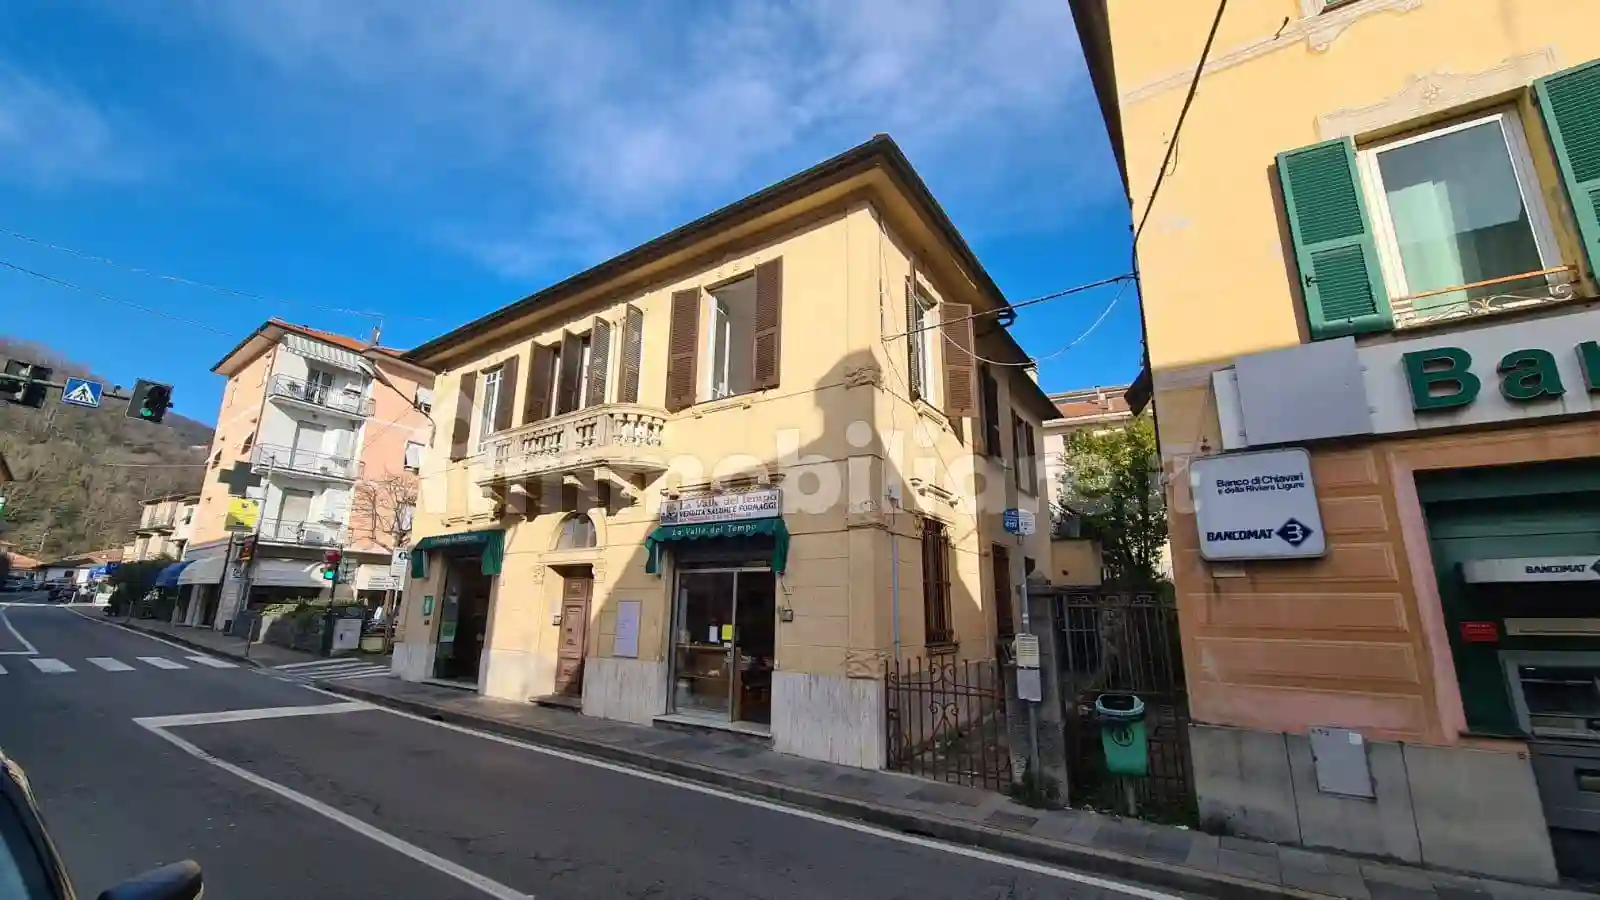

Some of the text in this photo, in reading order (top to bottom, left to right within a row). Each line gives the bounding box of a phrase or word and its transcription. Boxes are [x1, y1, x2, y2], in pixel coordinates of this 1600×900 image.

[1216, 472, 1304, 488] Banco di Chiavari
[1224, 485, 1245, 494] della
[1246, 484, 1276, 492] Riviera
[1277, 481, 1305, 492] Ligure
[679, 508, 706, 518] VENDITA
[739, 502, 777, 512] FORMAGGI
[672, 524, 757, 537] La Valle del Tempo
[1206, 528, 1274, 542] BANCOMAT
[1525, 564, 1588, 574] BANCOMAT
